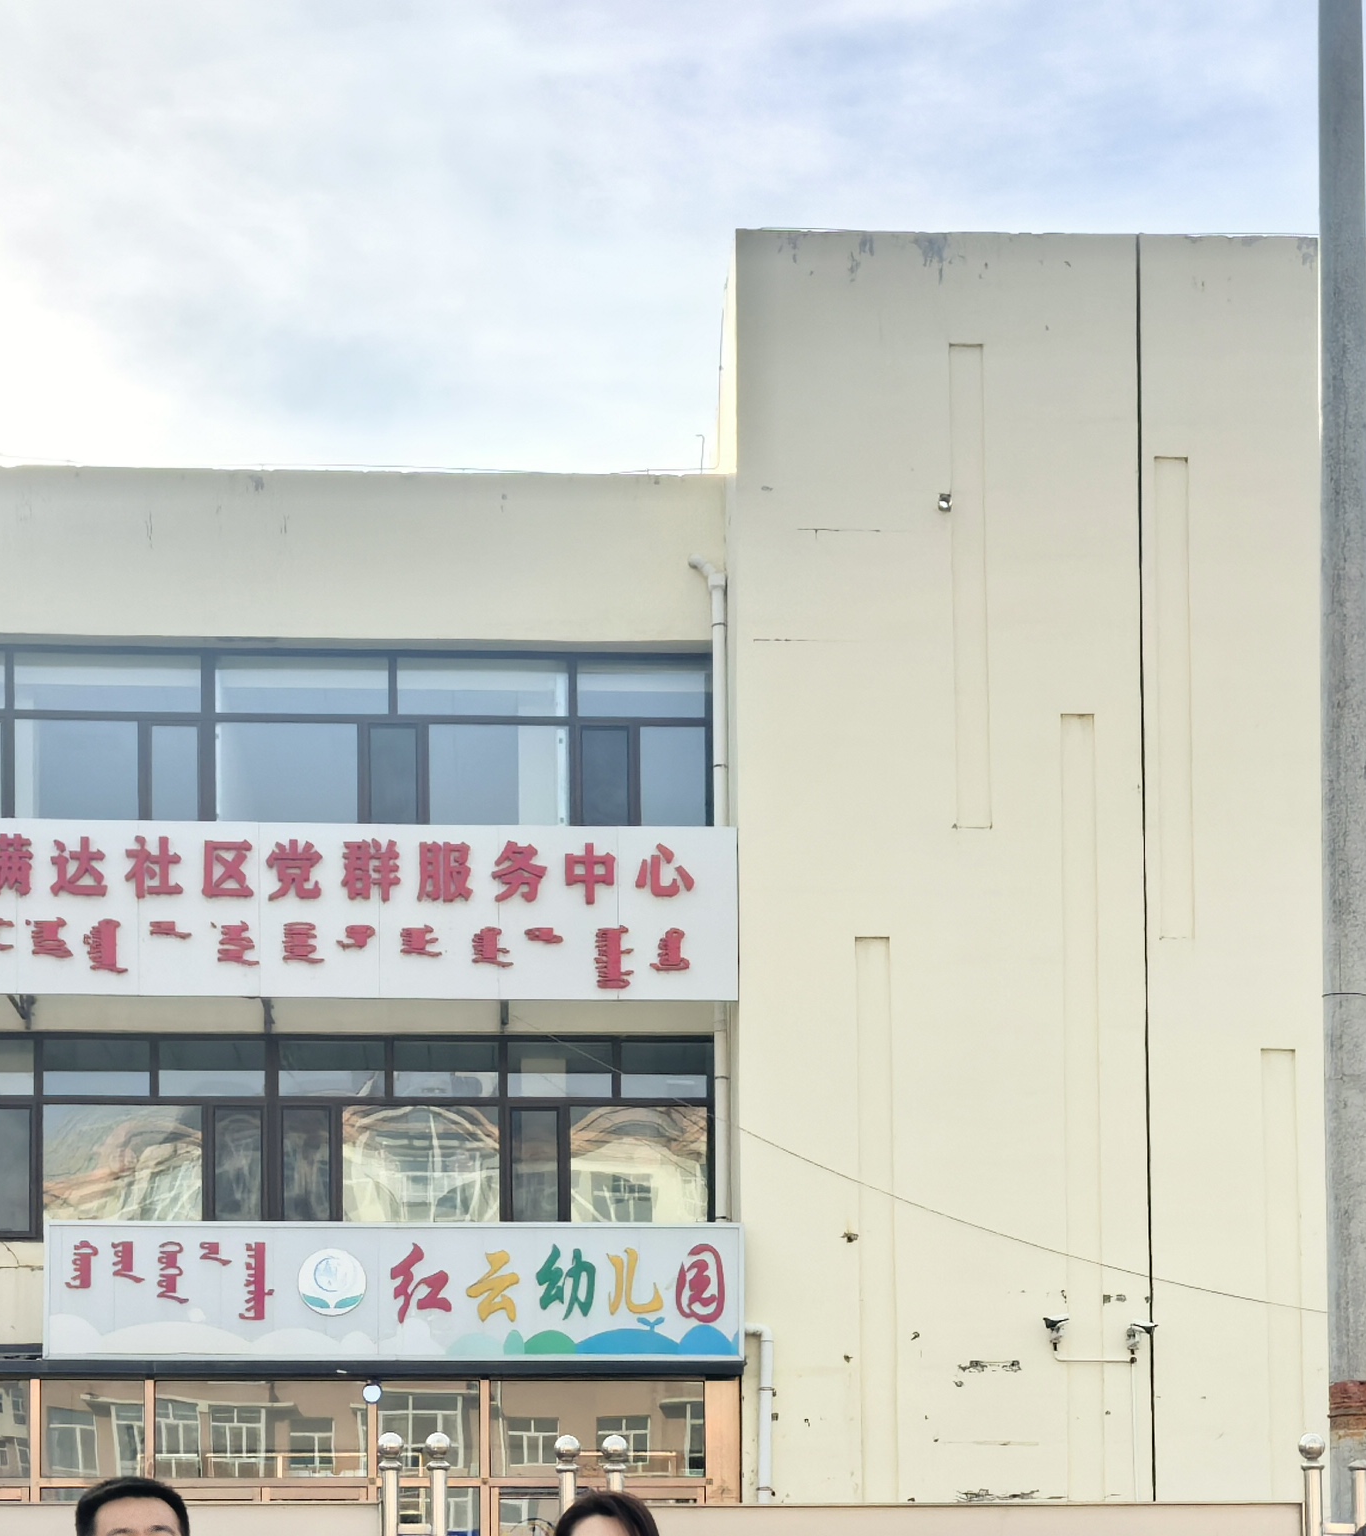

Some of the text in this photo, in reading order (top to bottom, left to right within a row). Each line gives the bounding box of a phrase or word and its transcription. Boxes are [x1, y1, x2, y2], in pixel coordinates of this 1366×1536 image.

[389, 1242, 726, 1324] 红云幼儿园
